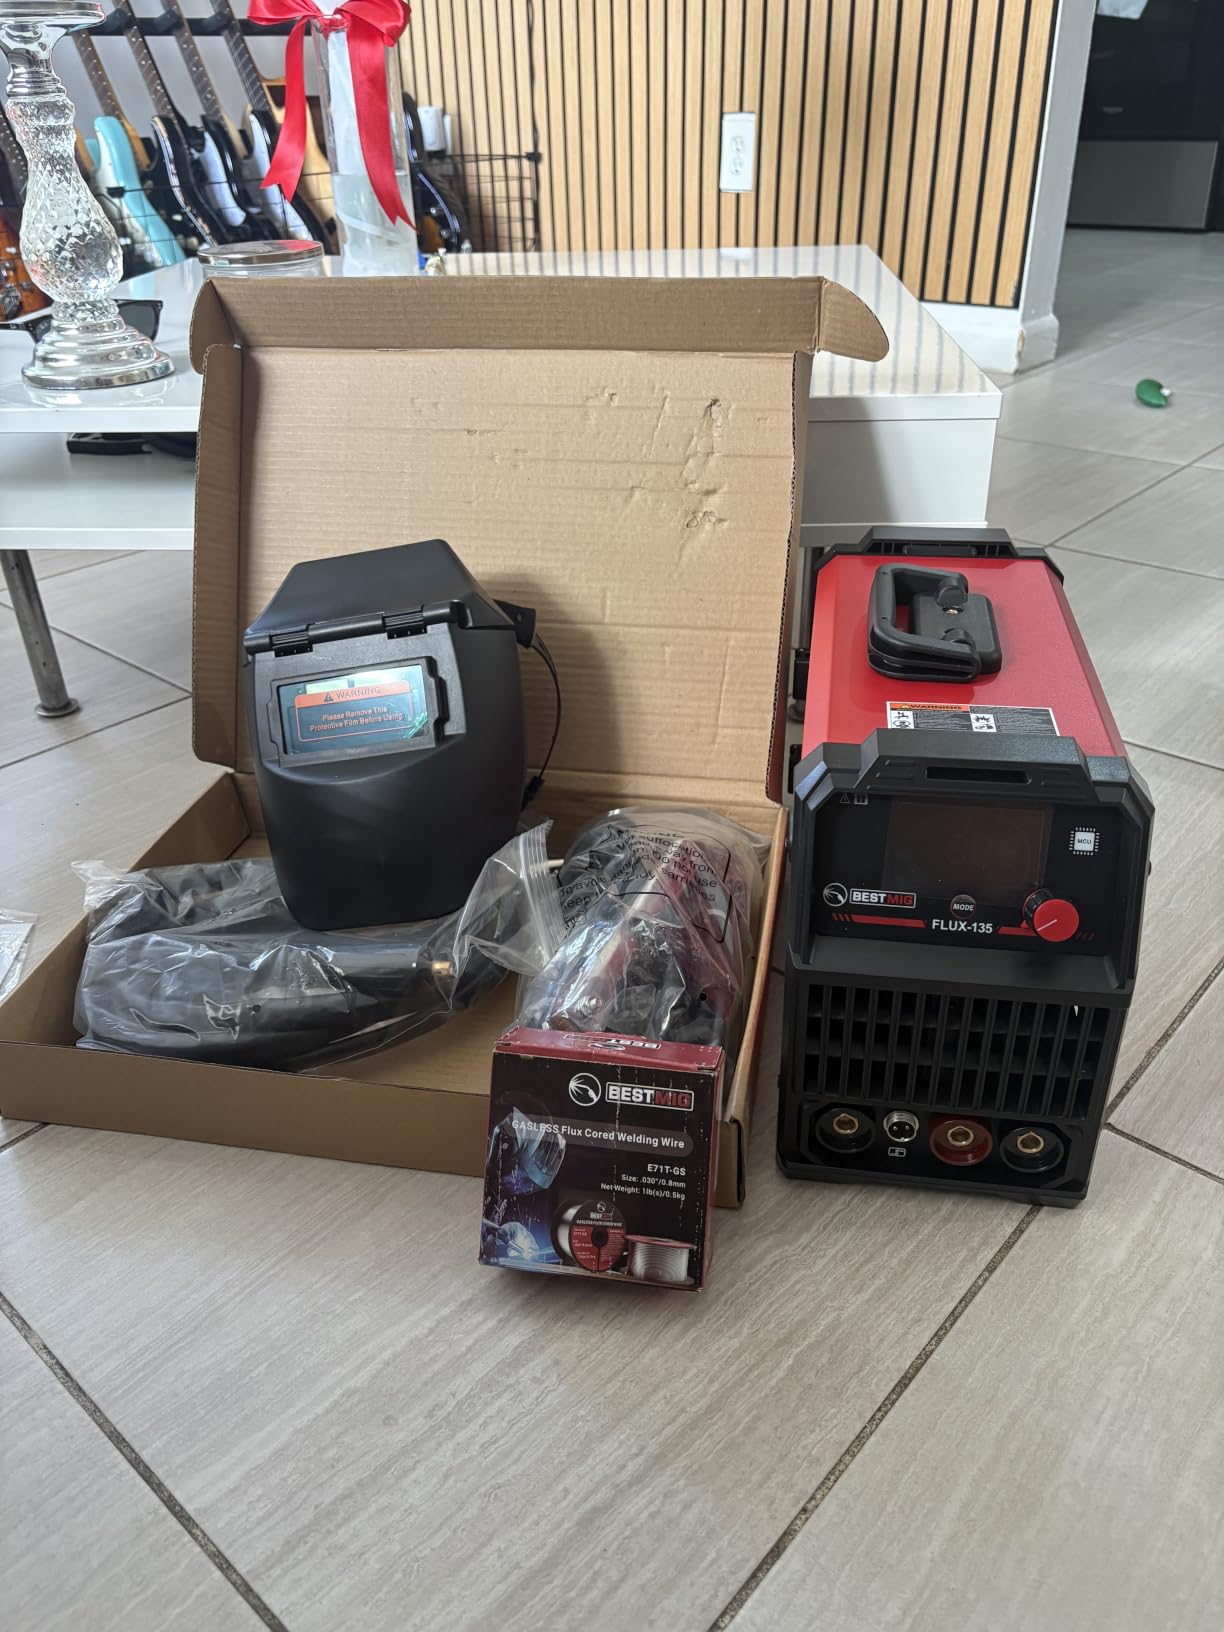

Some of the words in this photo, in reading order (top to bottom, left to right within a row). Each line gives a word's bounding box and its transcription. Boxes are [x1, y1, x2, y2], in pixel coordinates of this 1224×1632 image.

[336, 687, 381, 699] WARNING
[309, 721, 343, 731] Protective
[344, 719, 359, 727] Film
[360, 716, 383, 724] Before
[383, 712, 403, 720] Using
[322, 713, 345, 721] Please
[346, 708, 373, 718] Remove
[852, 891, 913, 905] BESTMIG
[952, 903, 975, 911] MODE
[931, 919, 993, 934] FLUX-135
[608, 1085, 691, 1108] BESTMIG
[511, 1120, 559, 1134] GASLESS
[561, 1125, 583, 1137] Flux
[584, 1128, 615, 1141] Cored
[616, 1131, 659, 1148] Welding
[661, 1136, 685, 1149] Wire
[647, 1163, 686, 1176] E71T-GS
[621, 1173, 639, 1182] Size:
[600, 1182, 613, 1190] Net
[614, 1184, 640, 1195] Weight:
[642, 1187, 686, 1201] 1lb(s)/0.5kg
